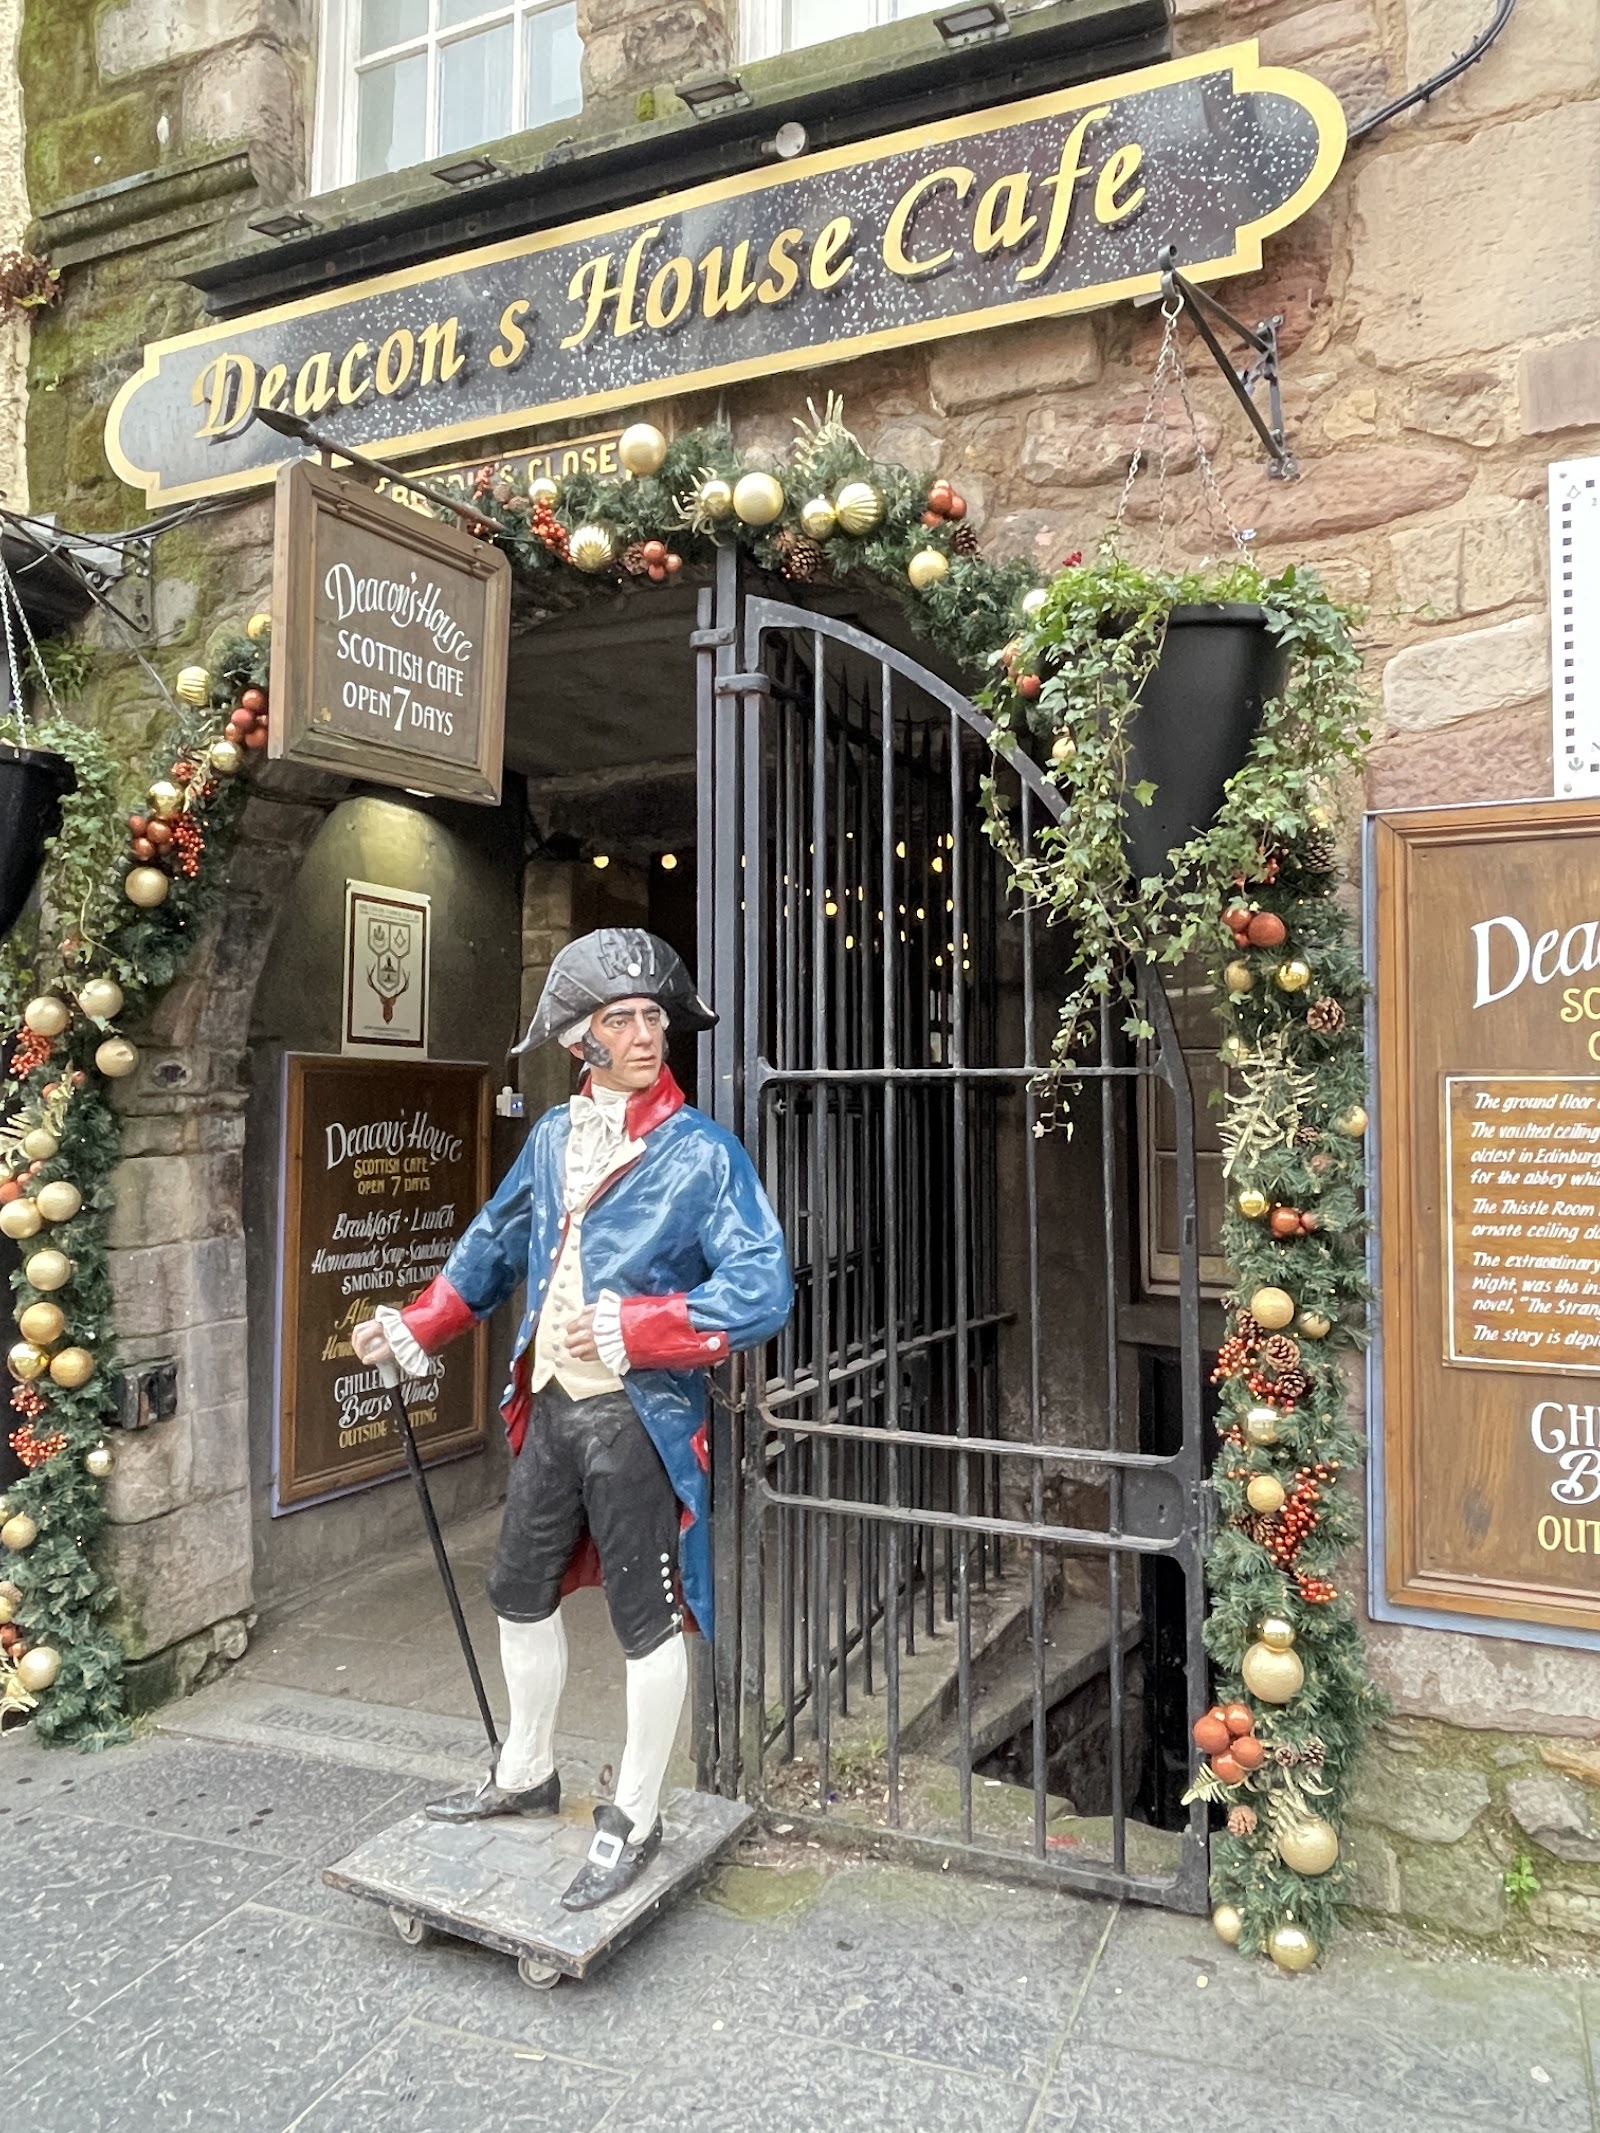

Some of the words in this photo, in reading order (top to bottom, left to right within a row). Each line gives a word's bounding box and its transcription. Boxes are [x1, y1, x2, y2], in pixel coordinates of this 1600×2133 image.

[559, 214, 855, 350] House
[881, 105, 1148, 283] Cafe
[528, 442, 618, 481] CLOSE
[325, 562, 420, 628] Deacon's
[416, 582, 474, 663] House
[336, 629, 423, 684] SCOTTISH
[426, 660, 465, 697] CAFE
[342, 681, 392, 719] OPEN
[393, 685, 412, 732] 7
[411, 703, 455, 737] DAYS
[1474, 1092, 1500, 1110] The
[1501, 1093, 1559, 1113] ground
[1559, 1093, 1596, 1110] floor
[325, 1108, 408, 1171] Deacon's
[407, 1110, 463, 1163] House
[1471, 1121, 1496, 1138] The
[1499, 1122, 1555, 1139] vaulted
[1470, 1147, 1516, 1163] oldest
[1518, 1147, 1534, 1163] in
[353, 1158, 401, 1180] SCOTTISH
[403, 1156, 429, 1174] CAFE
[1470, 1168, 1495, 1185] for
[1497, 1170, 1521, 1185] the
[1523, 1170, 1567, 1189] abbey
[357, 1179, 386, 1196] OPEN
[390, 1175, 402, 1197] 7
[404, 1176, 431, 1193] DAYS
[1472, 1197, 1497, 1214] The
[1500, 1198, 1549, 1216] Thistle
[1551, 1200, 1595, 1217] Room
[332, 1208, 403, 1246] Breakfast
[411, 1203, 456, 1232] Lunch
[1471, 1223, 1522, 1238] ornate
[1526, 1222, 1580, 1243] ceiling
[311, 1243, 381, 1275] Homemade
[1472, 1251, 1500, 1268] The
[341, 1270, 394, 1296] SMOKED
[1472, 1273, 1518, 1294] night,
[1521, 1279, 1552, 1293] was
[1554, 1278, 1579, 1294] the
[1472, 1298, 1516, 1315] novel,
[1473, 1324, 1499, 1342] The
[1502, 1327, 1544, 1347] story
[1546, 1328, 1561, 1344] is
[338, 1419, 389, 1449] OUTSIDE
